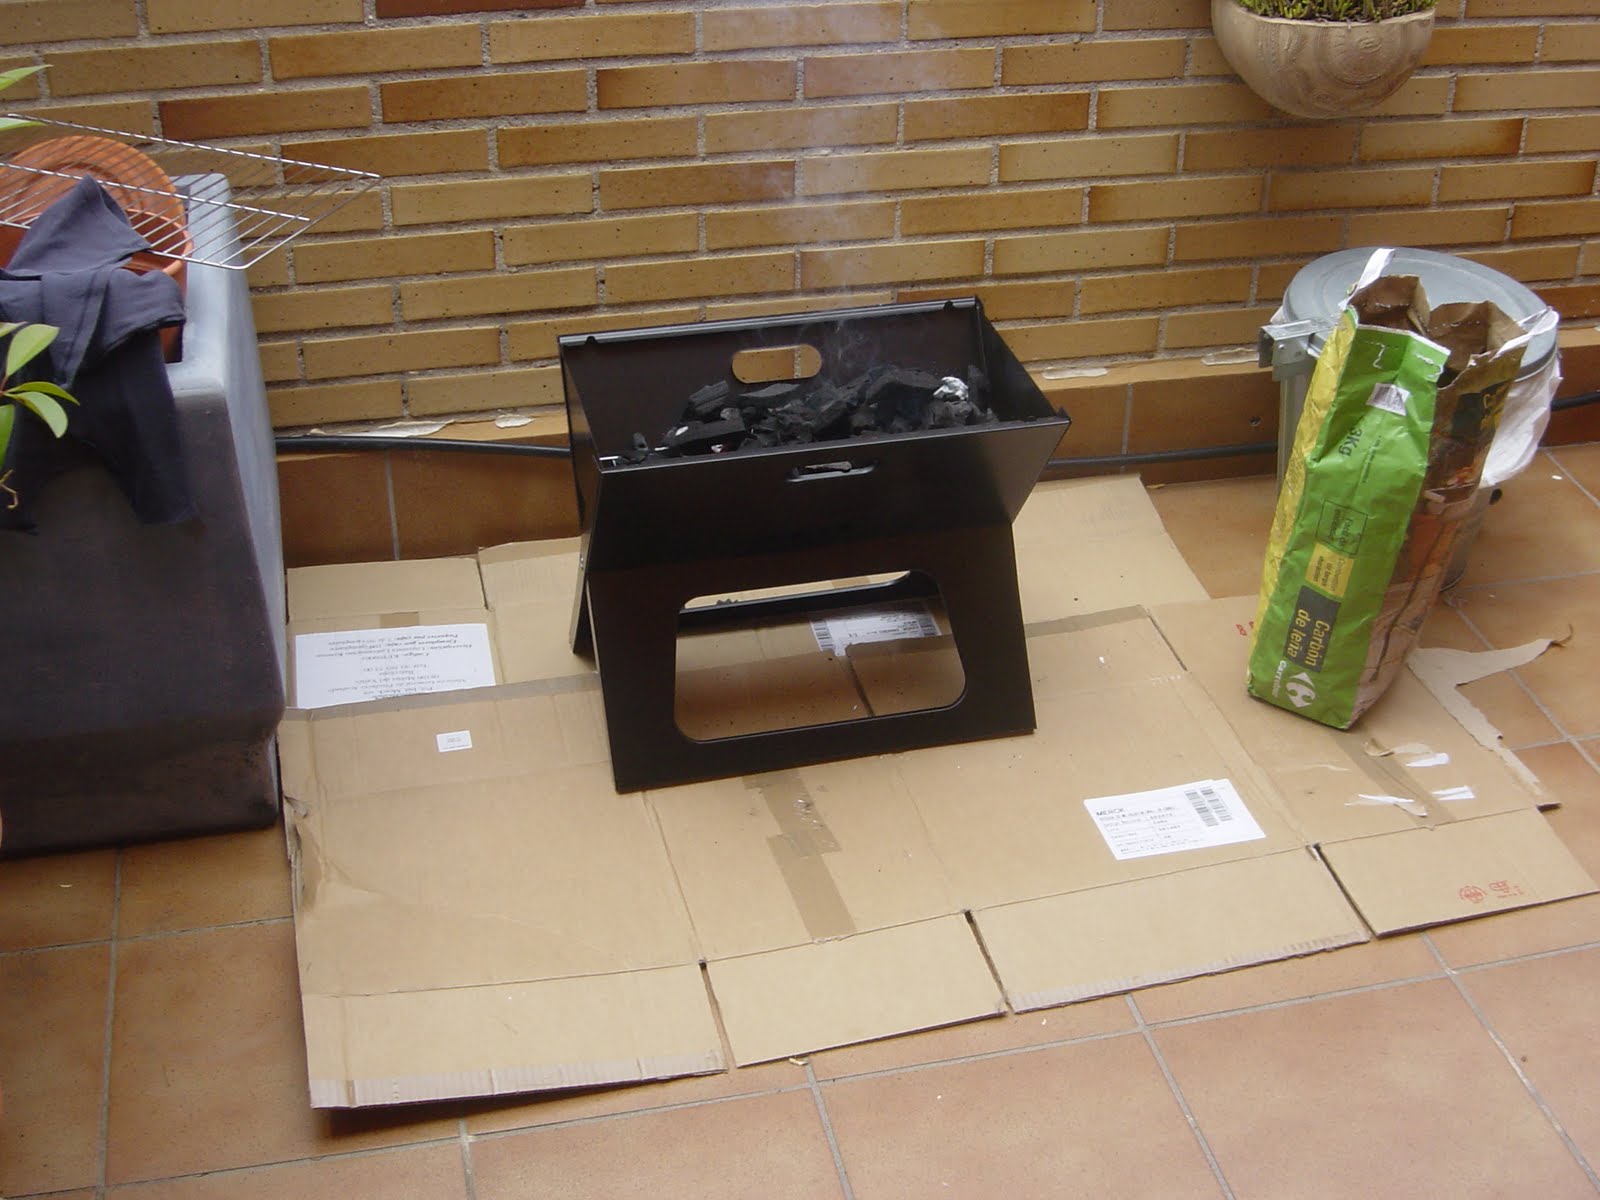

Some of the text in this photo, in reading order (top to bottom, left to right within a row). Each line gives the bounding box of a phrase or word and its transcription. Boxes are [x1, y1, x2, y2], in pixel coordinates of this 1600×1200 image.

[1339, 427, 1361, 457] 3Kg
[1287, 609, 1311, 658] de leña
[1305, 620, 1330, 667] Carbón
